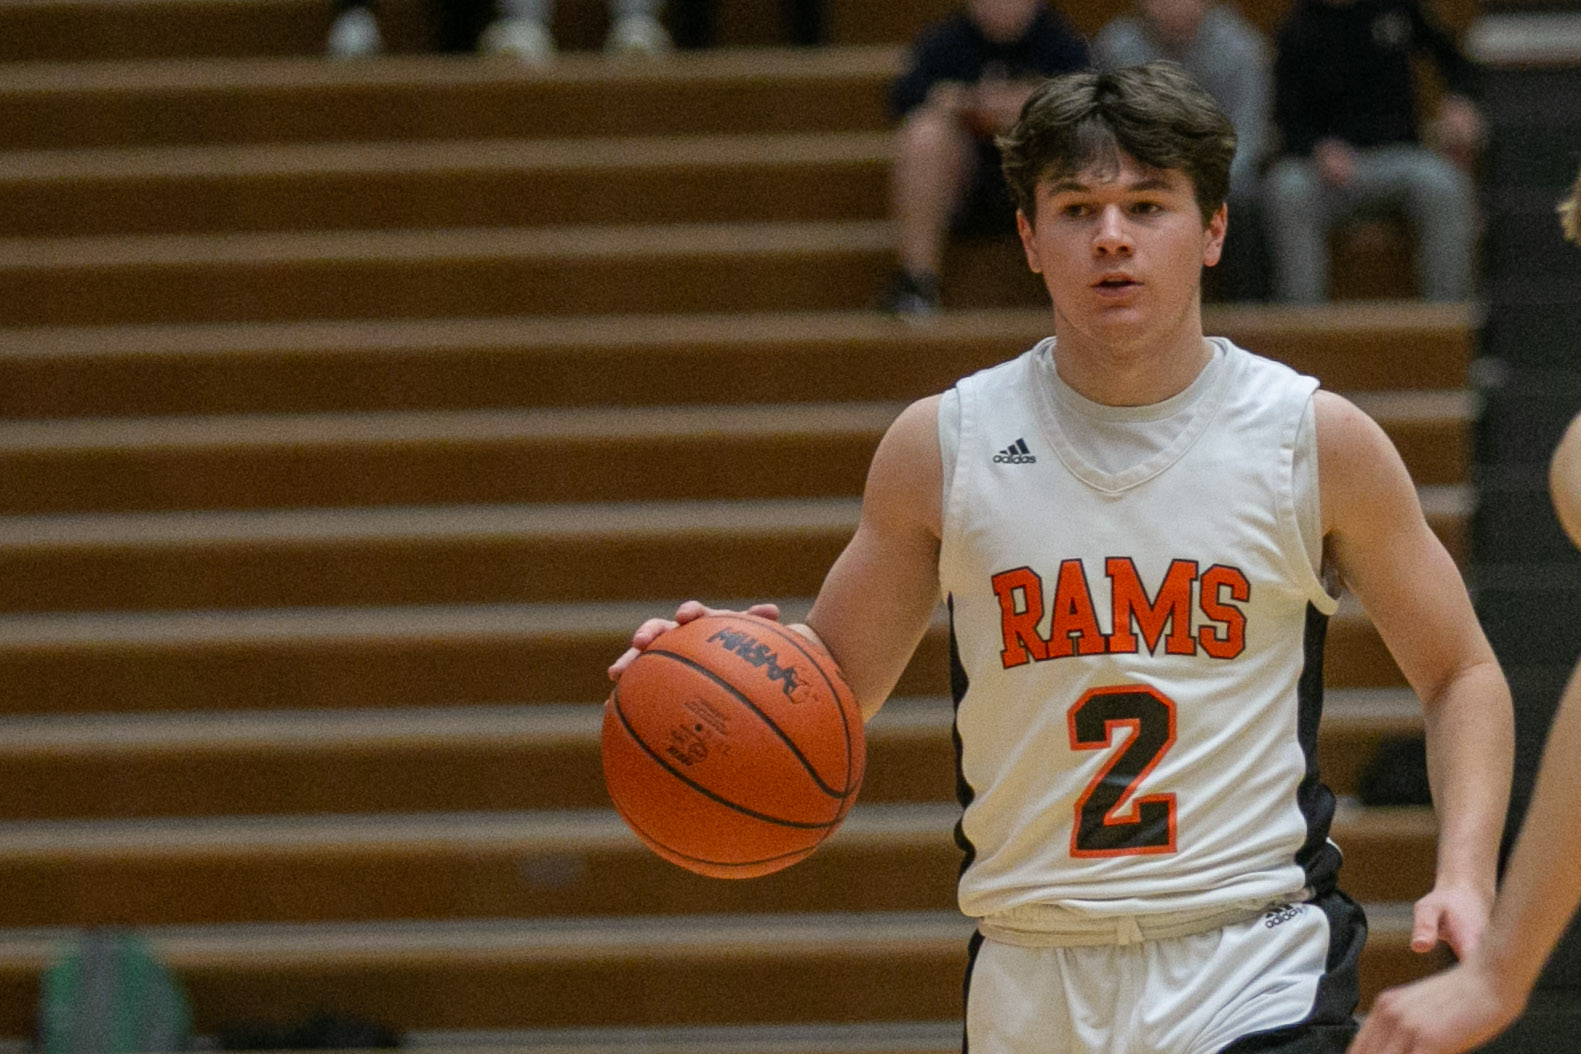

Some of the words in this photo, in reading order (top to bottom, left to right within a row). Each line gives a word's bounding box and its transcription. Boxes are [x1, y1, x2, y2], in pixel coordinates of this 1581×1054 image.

[993, 453, 1037, 464] adidas
[991, 556, 1251, 669] RAMS
[1067, 683, 1177, 858] 2
